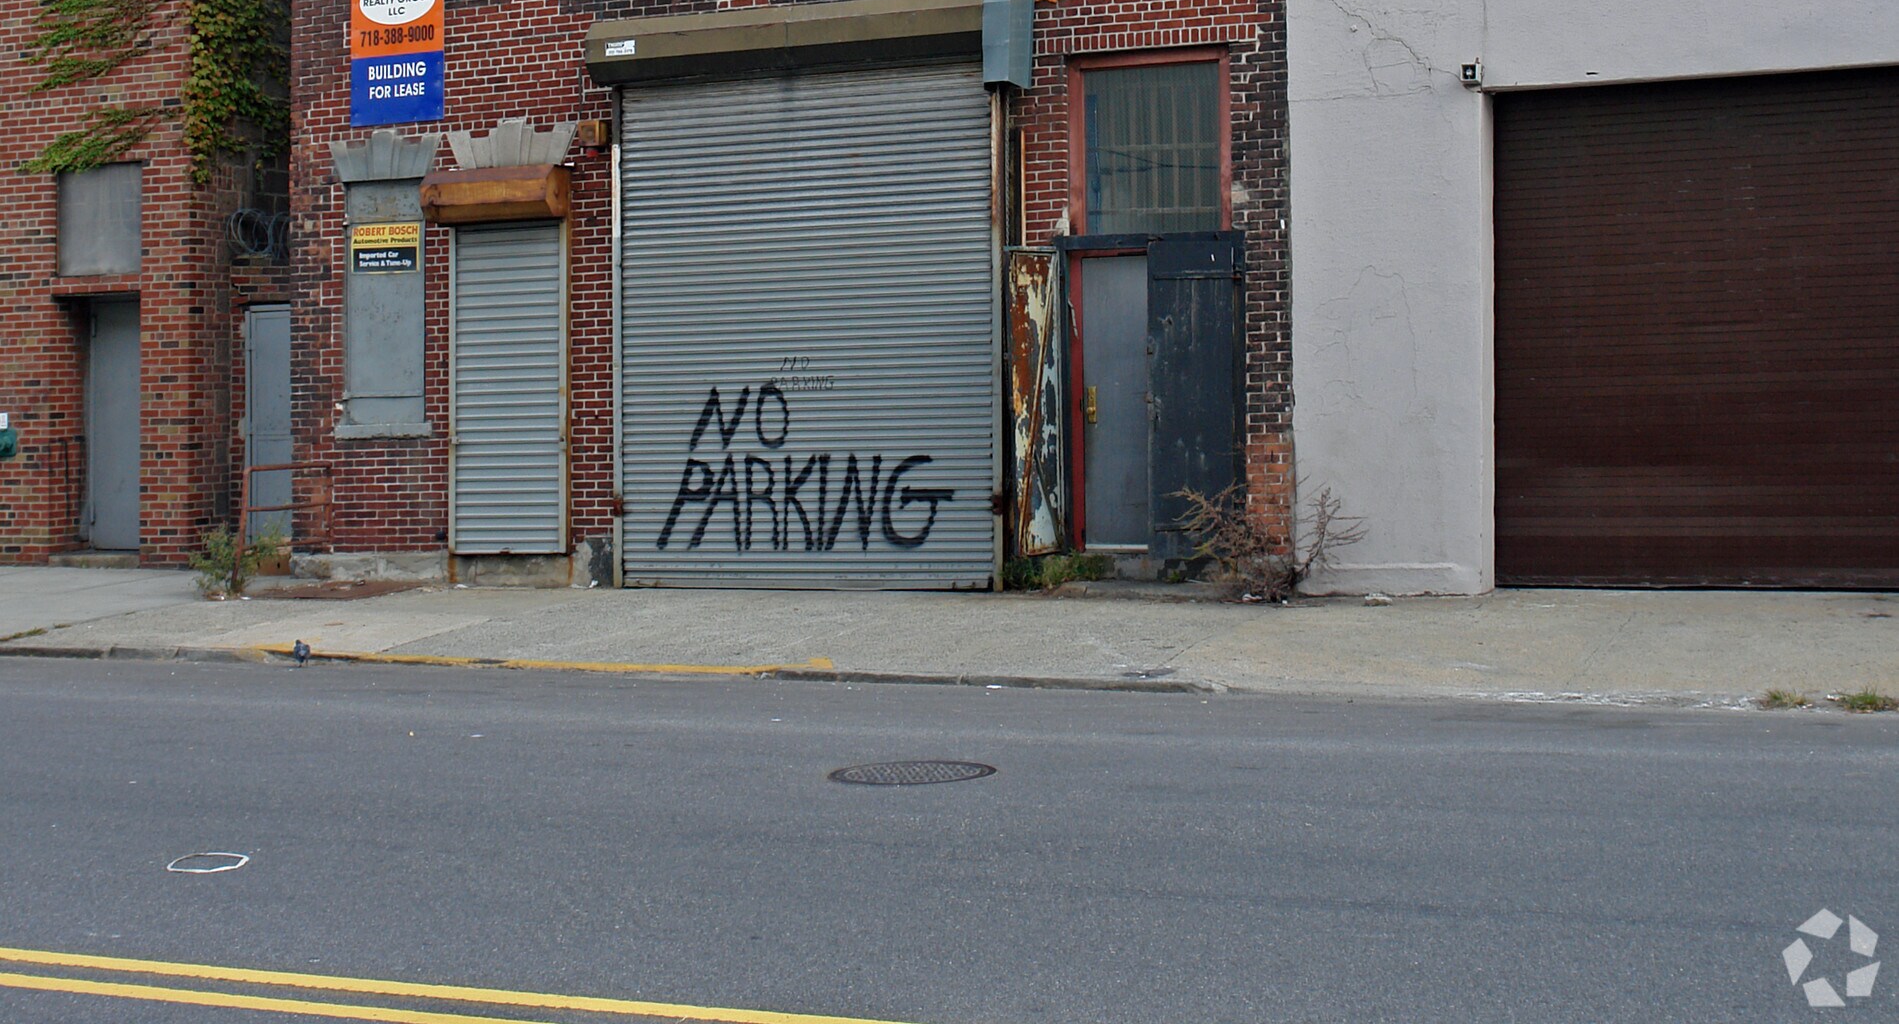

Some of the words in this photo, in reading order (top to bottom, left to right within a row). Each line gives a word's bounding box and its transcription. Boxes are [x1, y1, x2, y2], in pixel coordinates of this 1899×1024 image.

[388, 6, 406, 16] LLC
[360, 24, 434, 48] 718-388-9000
[368, 61, 427, 81] BUILDING
[369, 84, 391, 100] FOR
[393, 82, 425, 97] LEASE
[353, 227, 386, 236] ROBERT
[388, 225, 418, 236] BOSCH
[359, 252, 387, 260] Imported
[780, 356, 810, 371] NO
[689, 383, 790, 451] NO
[656, 453, 955, 552] PARKING
